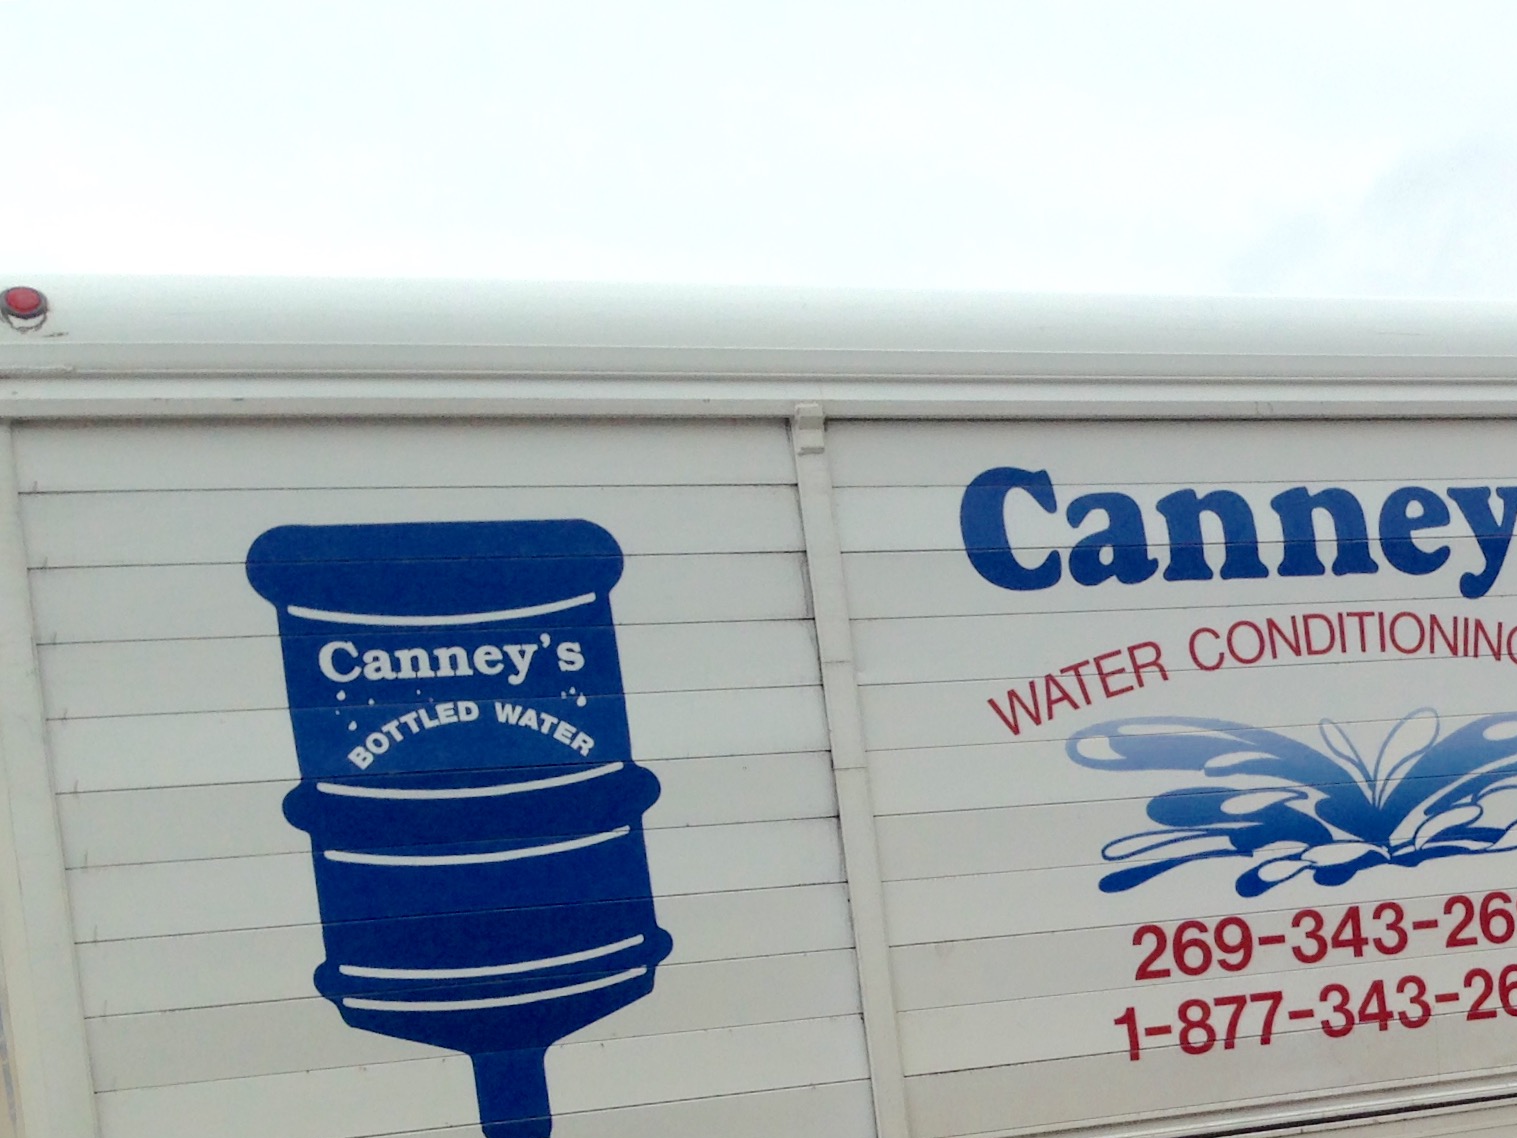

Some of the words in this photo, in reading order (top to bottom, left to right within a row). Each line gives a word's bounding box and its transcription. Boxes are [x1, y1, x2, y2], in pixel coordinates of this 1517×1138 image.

[318, 633, 585, 685] Canney's
[988, 640, 1169, 736] WATER
[348, 700, 480, 770] BOTTLED
[494, 701, 595, 756] WATER
